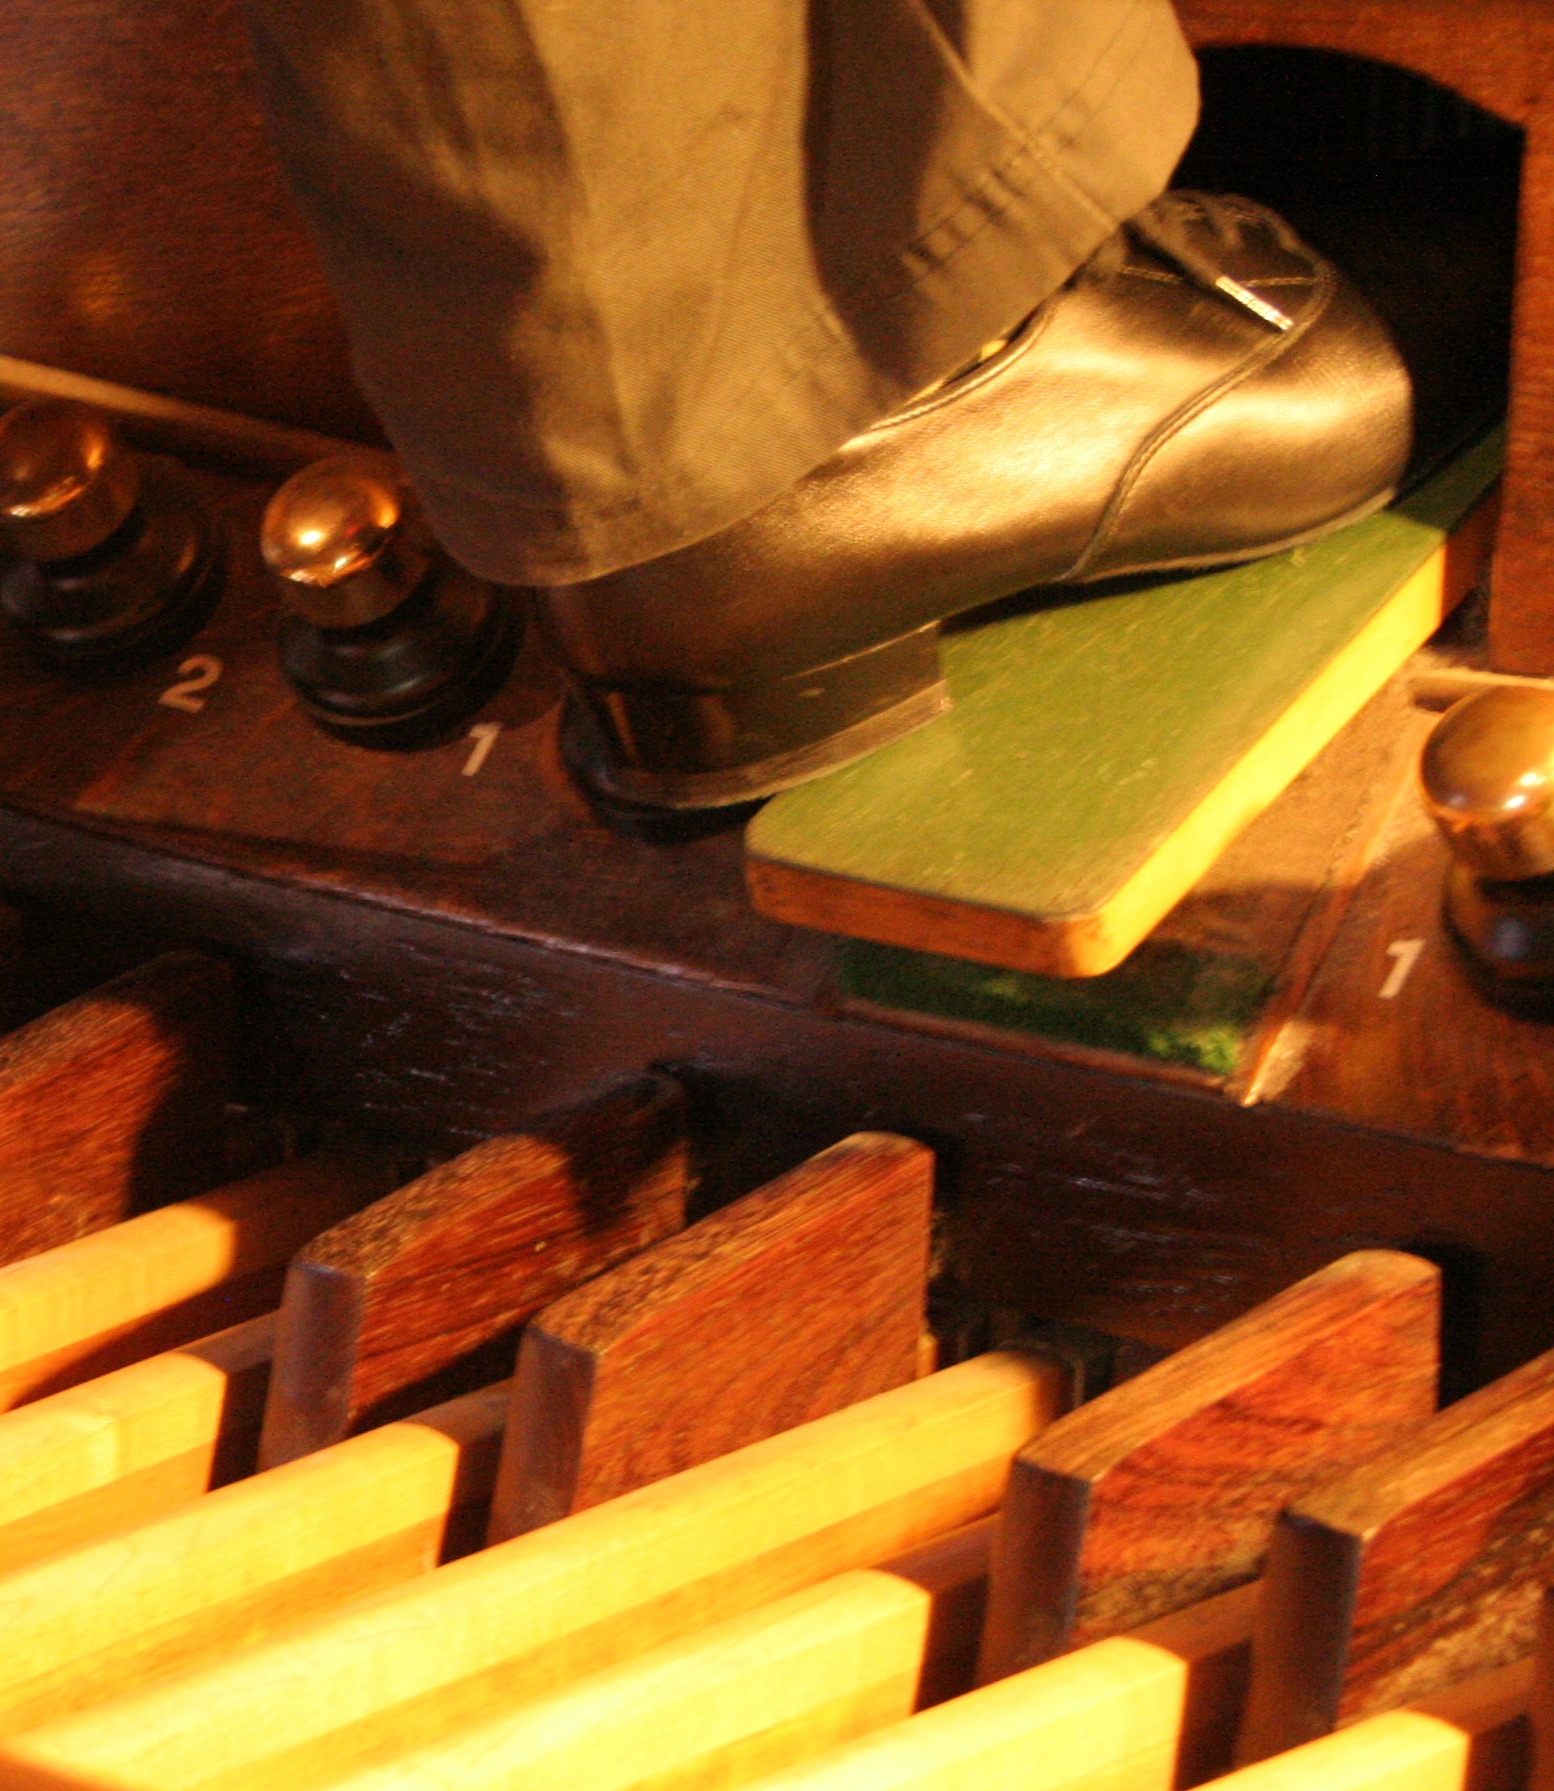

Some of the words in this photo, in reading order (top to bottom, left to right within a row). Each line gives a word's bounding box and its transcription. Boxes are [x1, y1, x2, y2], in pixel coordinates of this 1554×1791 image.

[159, 654, 224, 713] 2
[461, 721, 504, 777] 1
[1378, 938, 1426, 999] 1
